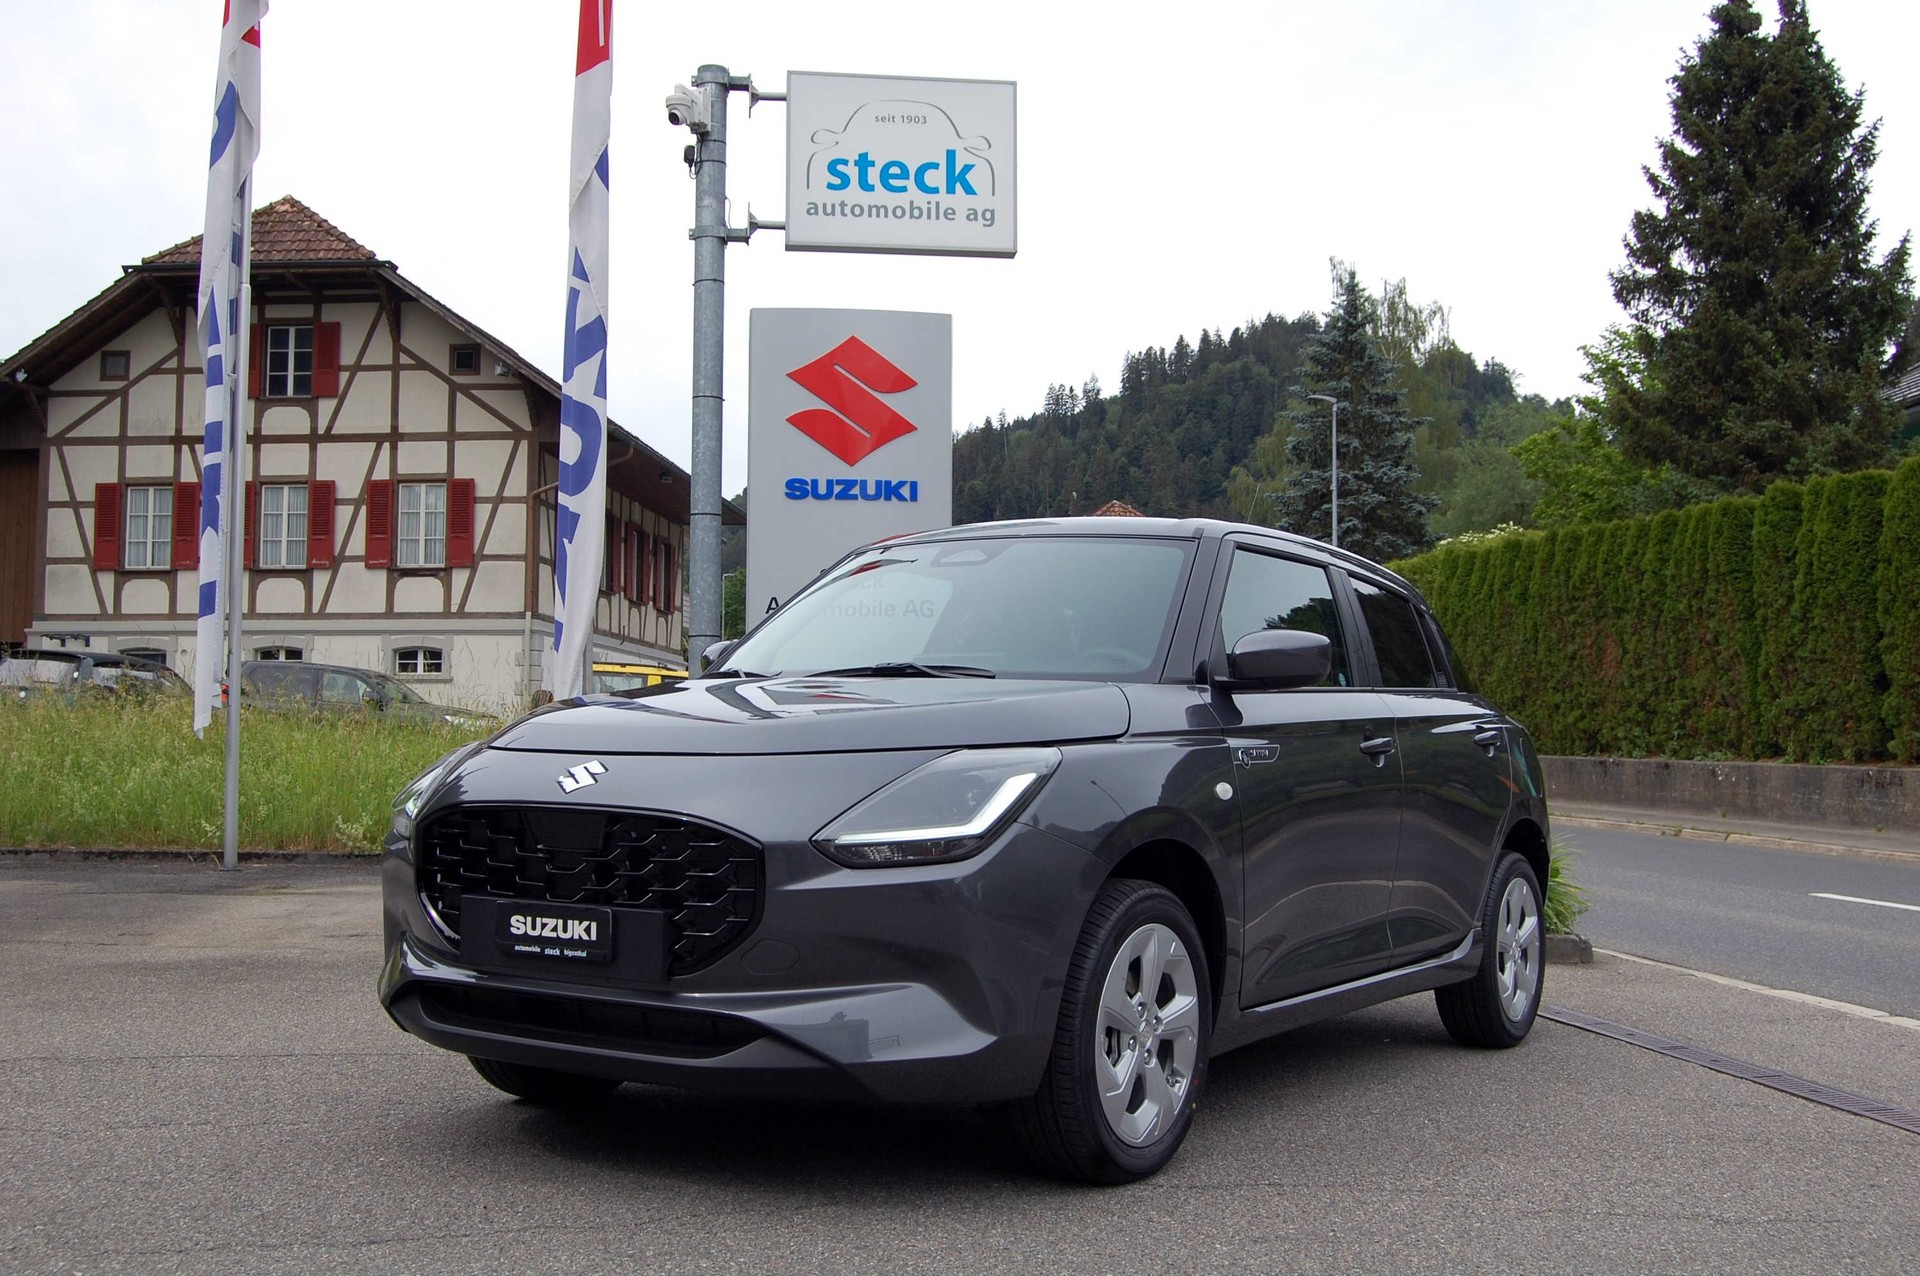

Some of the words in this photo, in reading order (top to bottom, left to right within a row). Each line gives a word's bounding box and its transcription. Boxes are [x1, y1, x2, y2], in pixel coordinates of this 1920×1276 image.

[874, 114, 896, 124] seit
[900, 114, 928, 125] 1903
[826, 149, 978, 196] steck
[806, 200, 956, 221] automobile
[965, 207, 996, 227] ag
[785, 477, 918, 502] SUZUKI
[902, 600, 935, 618] AG
[510, 915, 597, 941] SUZUKI
[514, 945, 541, 953] automobile
[545, 947, 560, 956] steck
